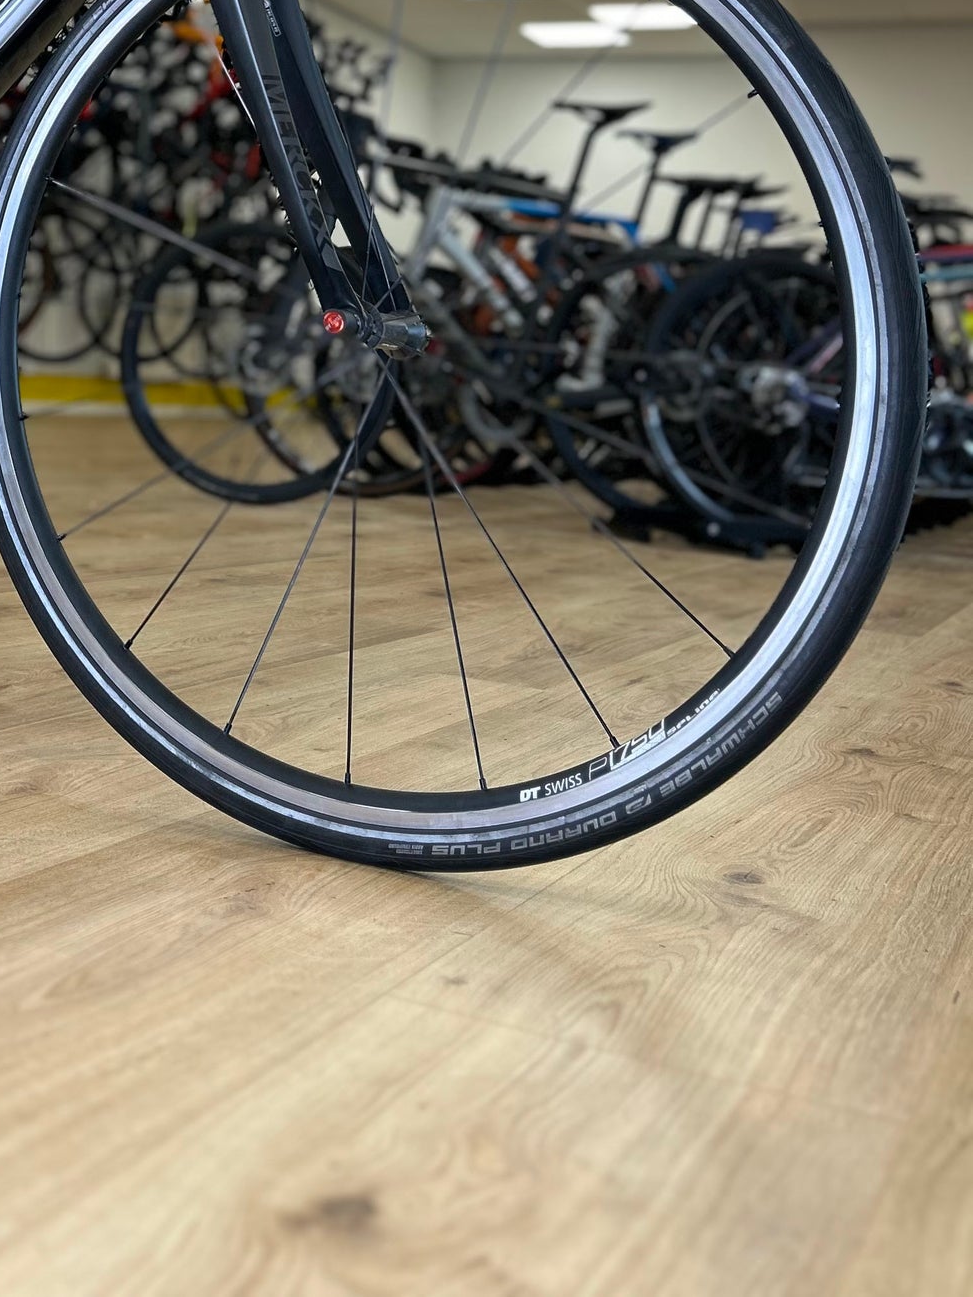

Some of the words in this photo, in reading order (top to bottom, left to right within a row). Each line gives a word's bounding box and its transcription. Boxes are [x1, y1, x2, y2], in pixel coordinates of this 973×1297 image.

[659, 691, 783, 798] SCHWALBE
[519, 786, 541, 802] DT
[544, 773, 583, 796] SWISS
[510, 810, 618, 851] DURANO
[431, 842, 502, 855] PLUS
